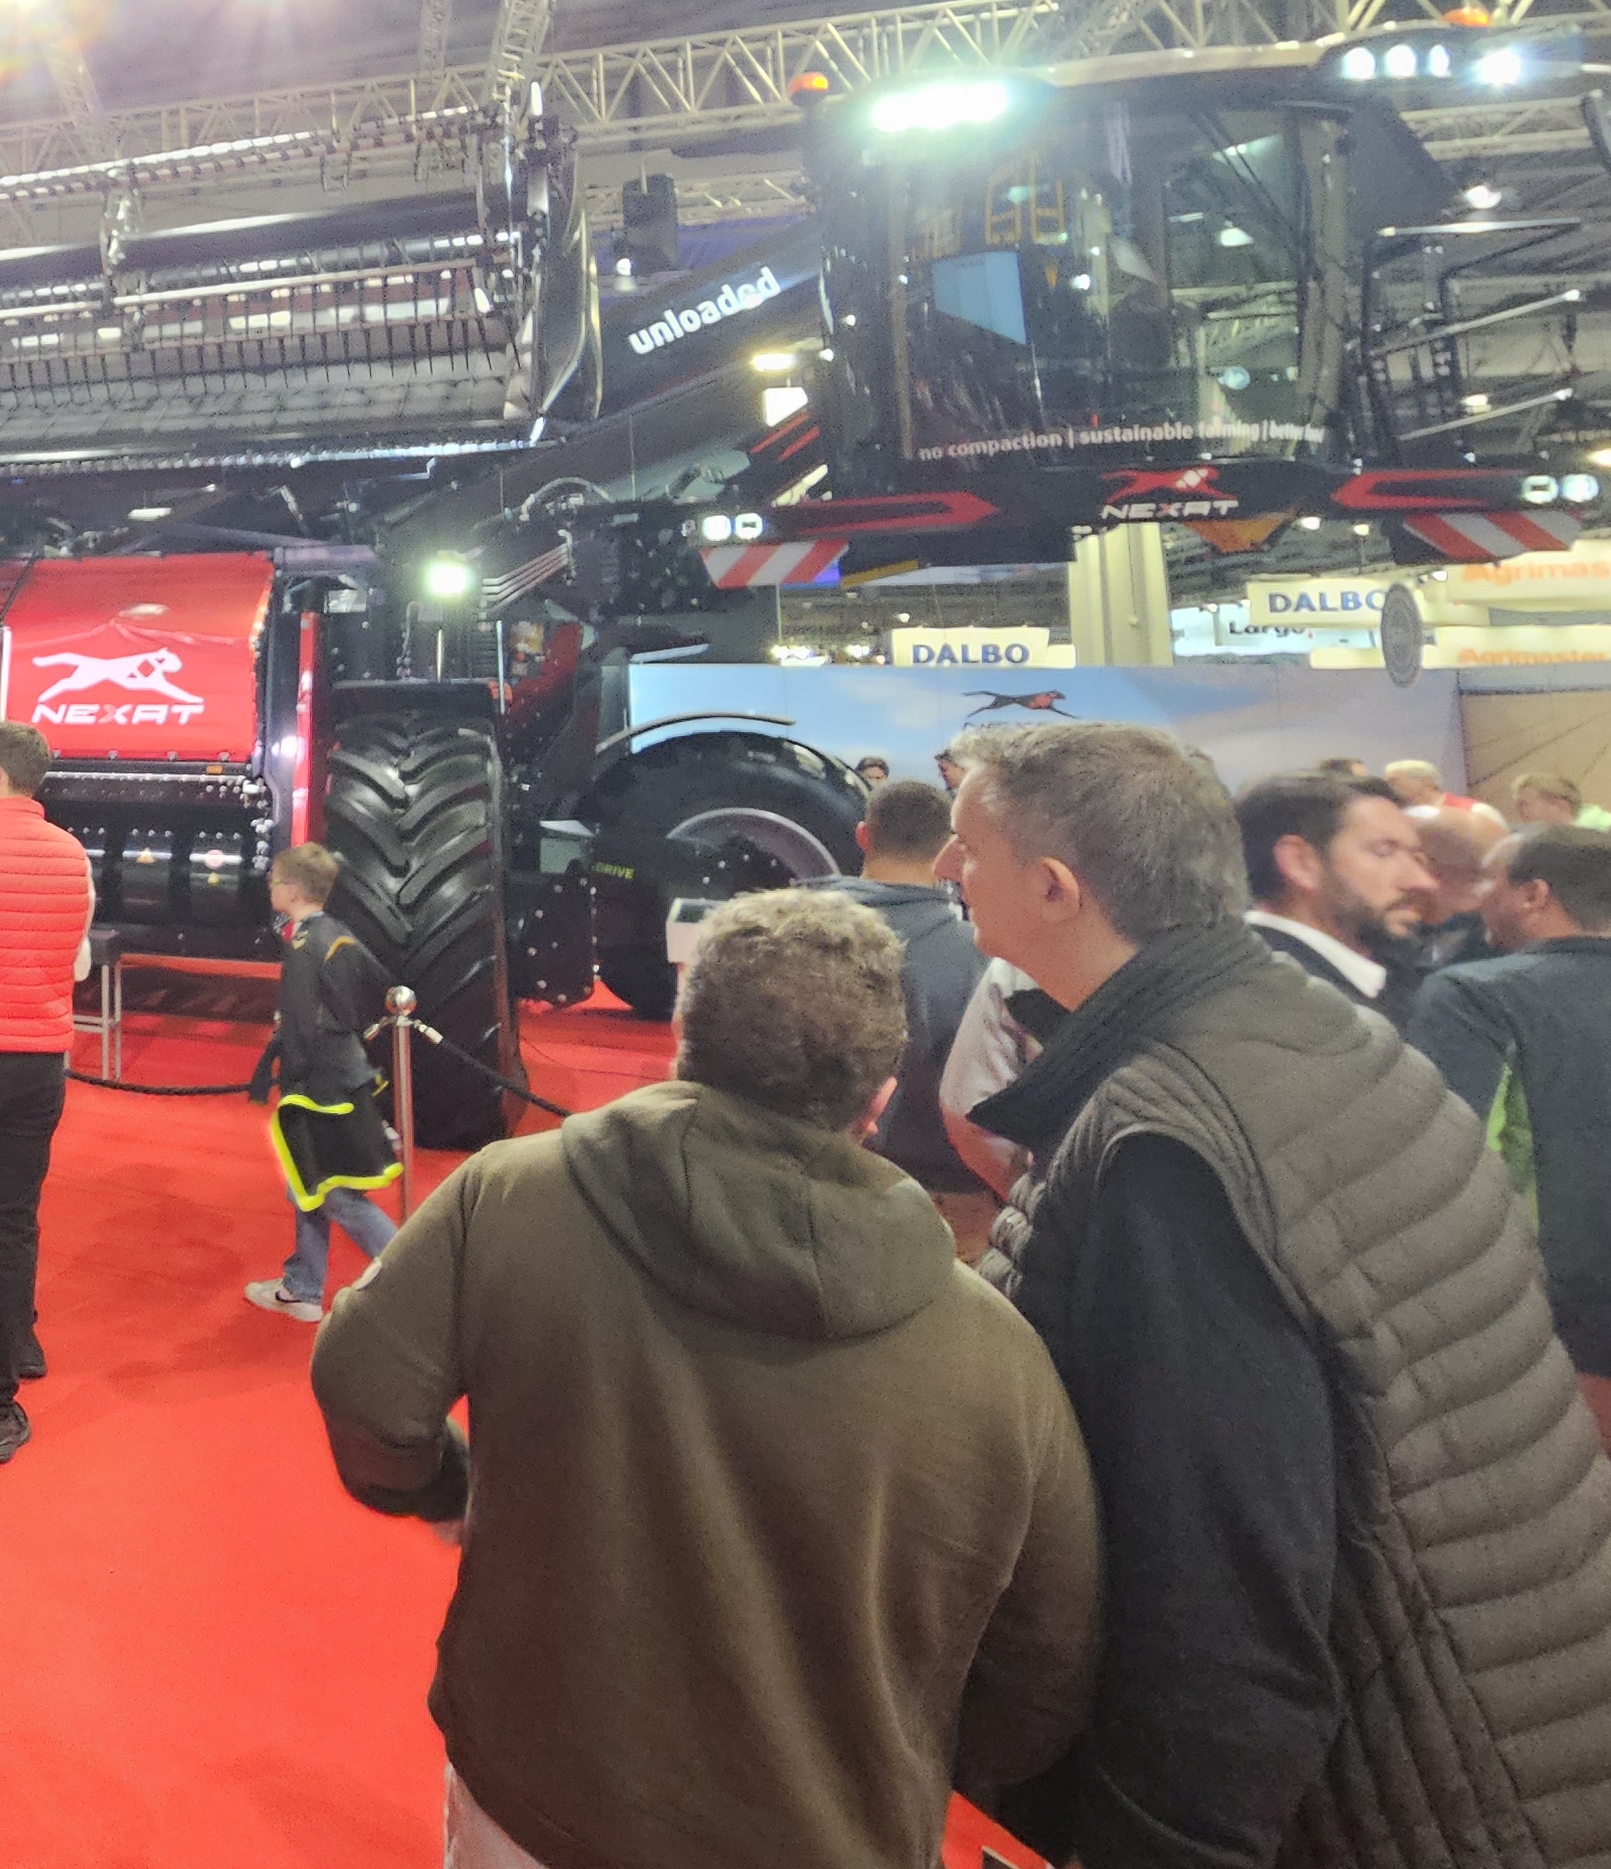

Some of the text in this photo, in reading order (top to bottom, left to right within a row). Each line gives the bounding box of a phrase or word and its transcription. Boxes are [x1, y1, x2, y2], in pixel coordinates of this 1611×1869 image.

[628, 265, 782, 355] unloaded
[919, 447, 944, 461] no
[948, 431, 1063, 457] compaction
[1079, 421, 1194, 445] sustainable
[1099, 500, 1240, 520] NEXAT
[912, 642, 1031, 664] DALBO
[31, 703, 206, 725] NEXAT
